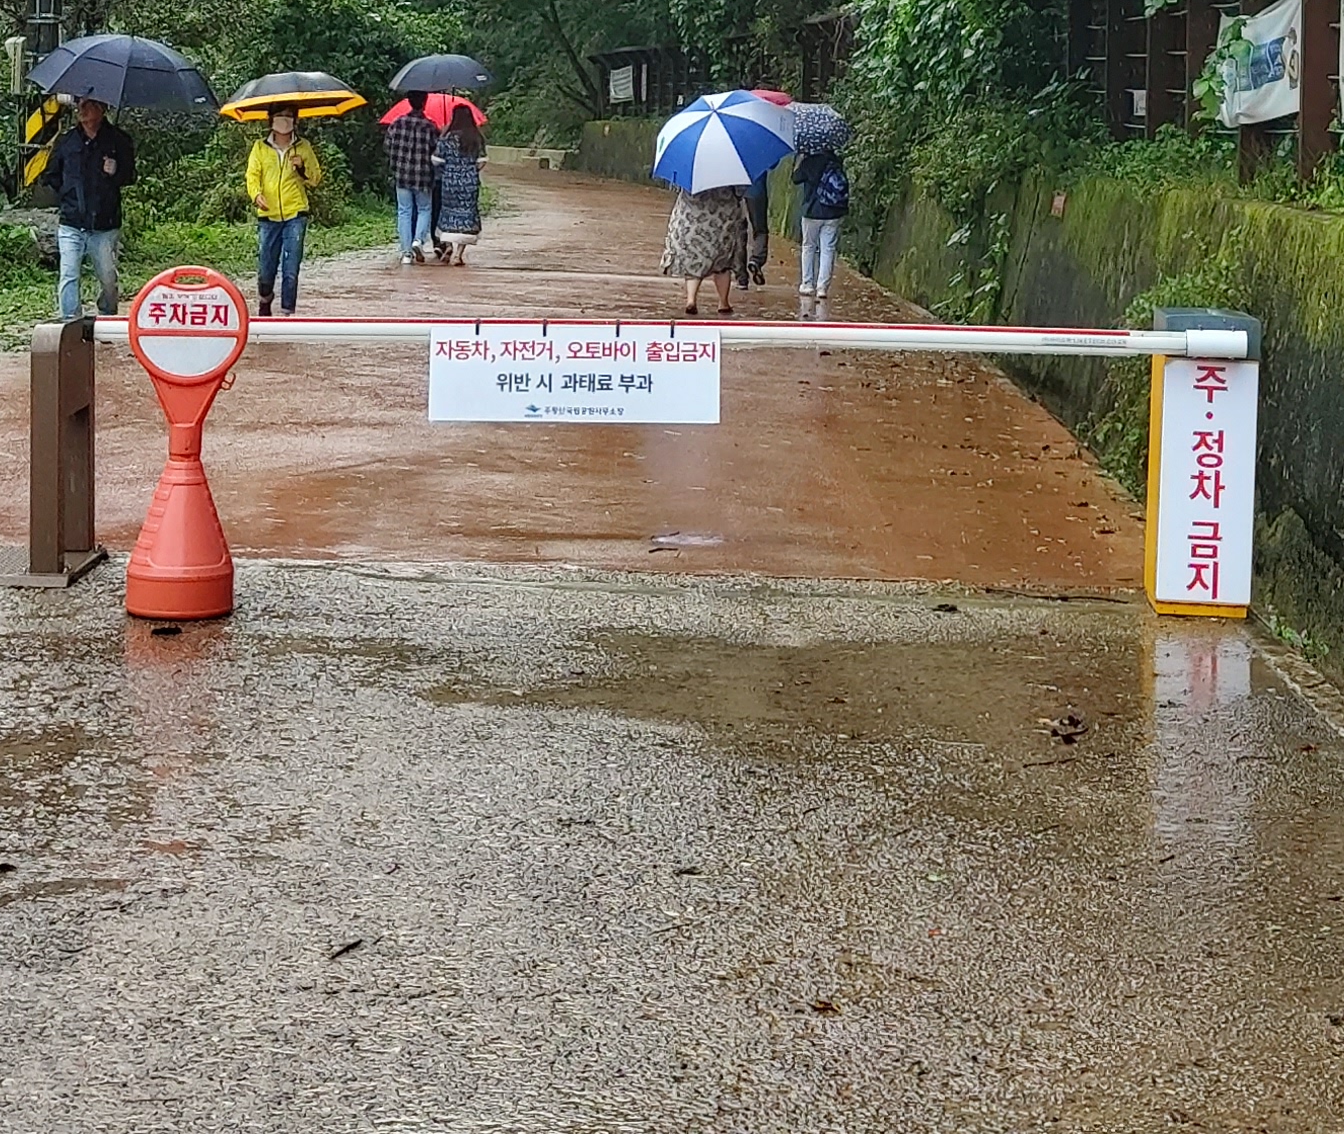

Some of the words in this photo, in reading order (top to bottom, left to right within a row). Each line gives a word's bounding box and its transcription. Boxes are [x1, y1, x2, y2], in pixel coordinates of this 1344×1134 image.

[148, 302, 229, 326] 주차금지
[435, 340, 496, 364] 자동차,
[500, 340, 561, 364] 자전거,
[566, 341, 638, 363] 오토바이
[644, 341, 717, 363] 출입금지
[495, 372, 532, 394] 위반
[536, 372, 553, 394] 시
[560, 373, 614, 394] 과태료
[617, 373, 654, 394] 부과
[1186, 520, 1223, 601] 금지
